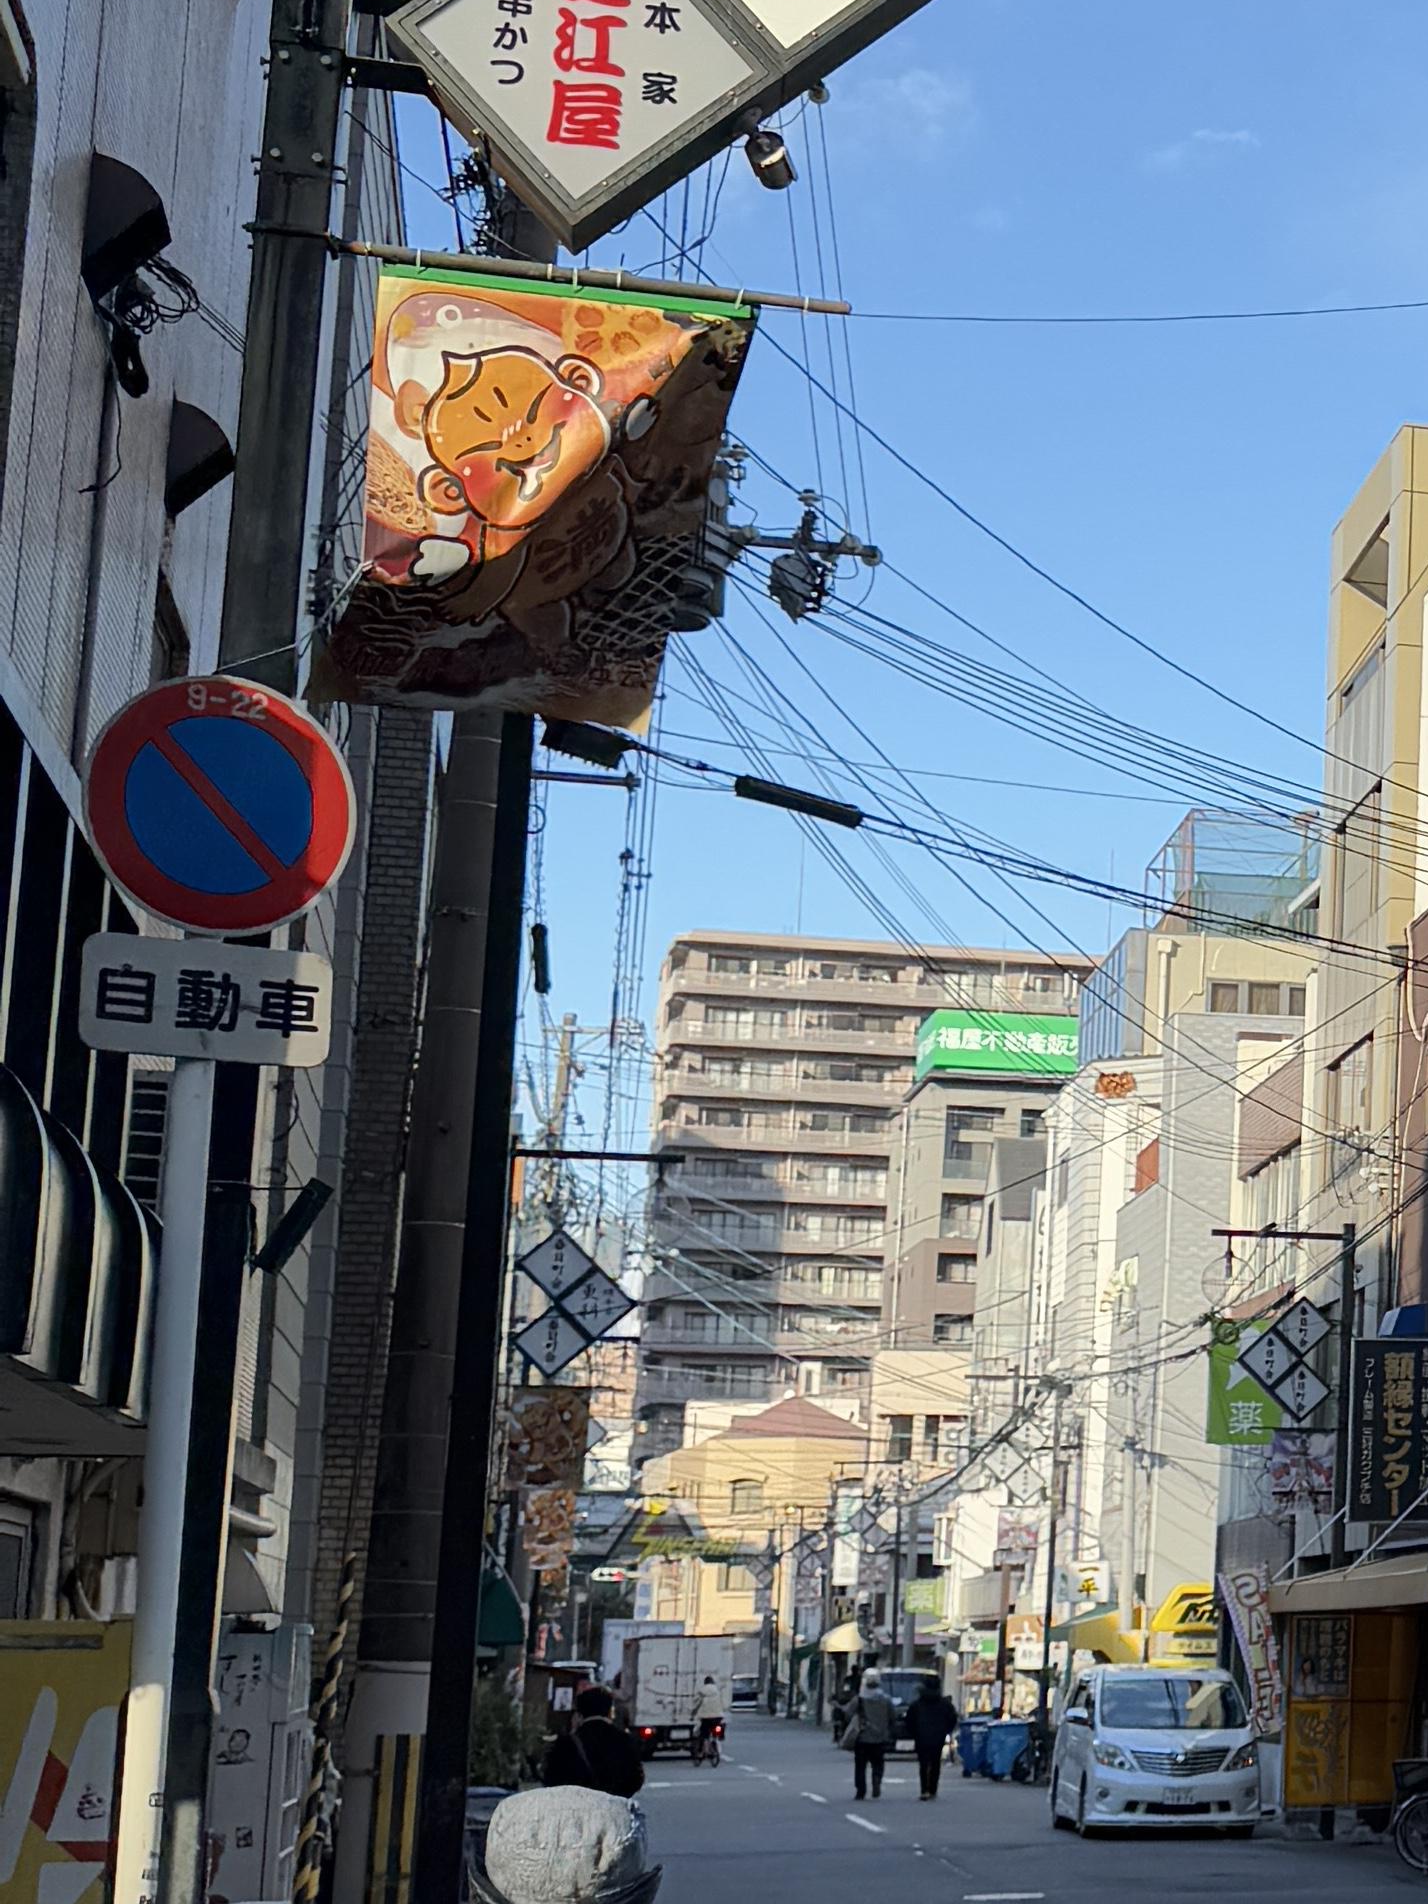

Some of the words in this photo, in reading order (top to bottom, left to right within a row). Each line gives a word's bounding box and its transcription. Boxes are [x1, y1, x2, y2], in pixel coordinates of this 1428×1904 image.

[641, 1, 682, 104] 本家
[95, 963, 320, 1038] 自動車
[1229, 1401, 1263, 1435] 薬
[1381, 1351, 1415, 1517] 額縁センター
